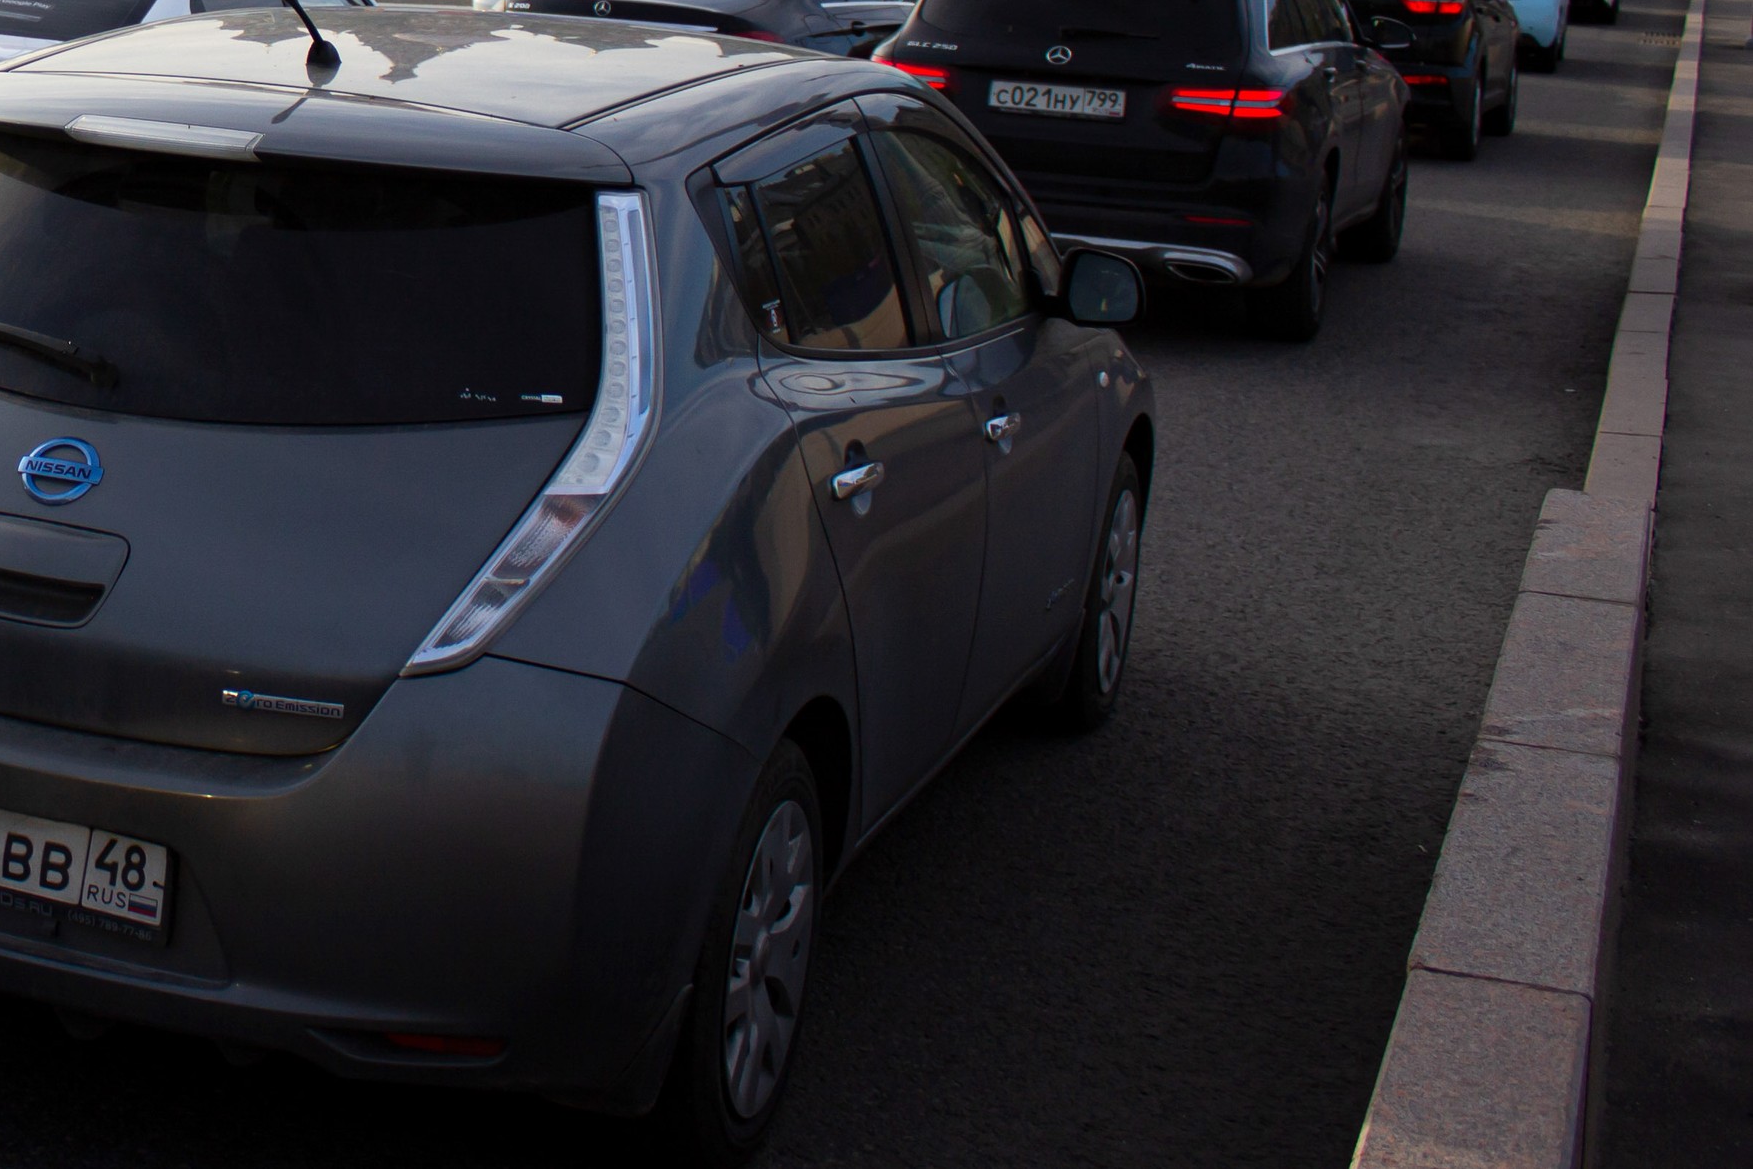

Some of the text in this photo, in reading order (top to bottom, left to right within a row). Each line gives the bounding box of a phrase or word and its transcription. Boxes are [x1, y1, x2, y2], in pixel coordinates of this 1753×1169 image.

[1086, 89, 1120, 108] 799
[25, 459, 92, 479] NISSAN
[275, 699, 342, 717] Emission
[94, 838, 147, 891] 48
[86, 884, 127, 909] RUS
